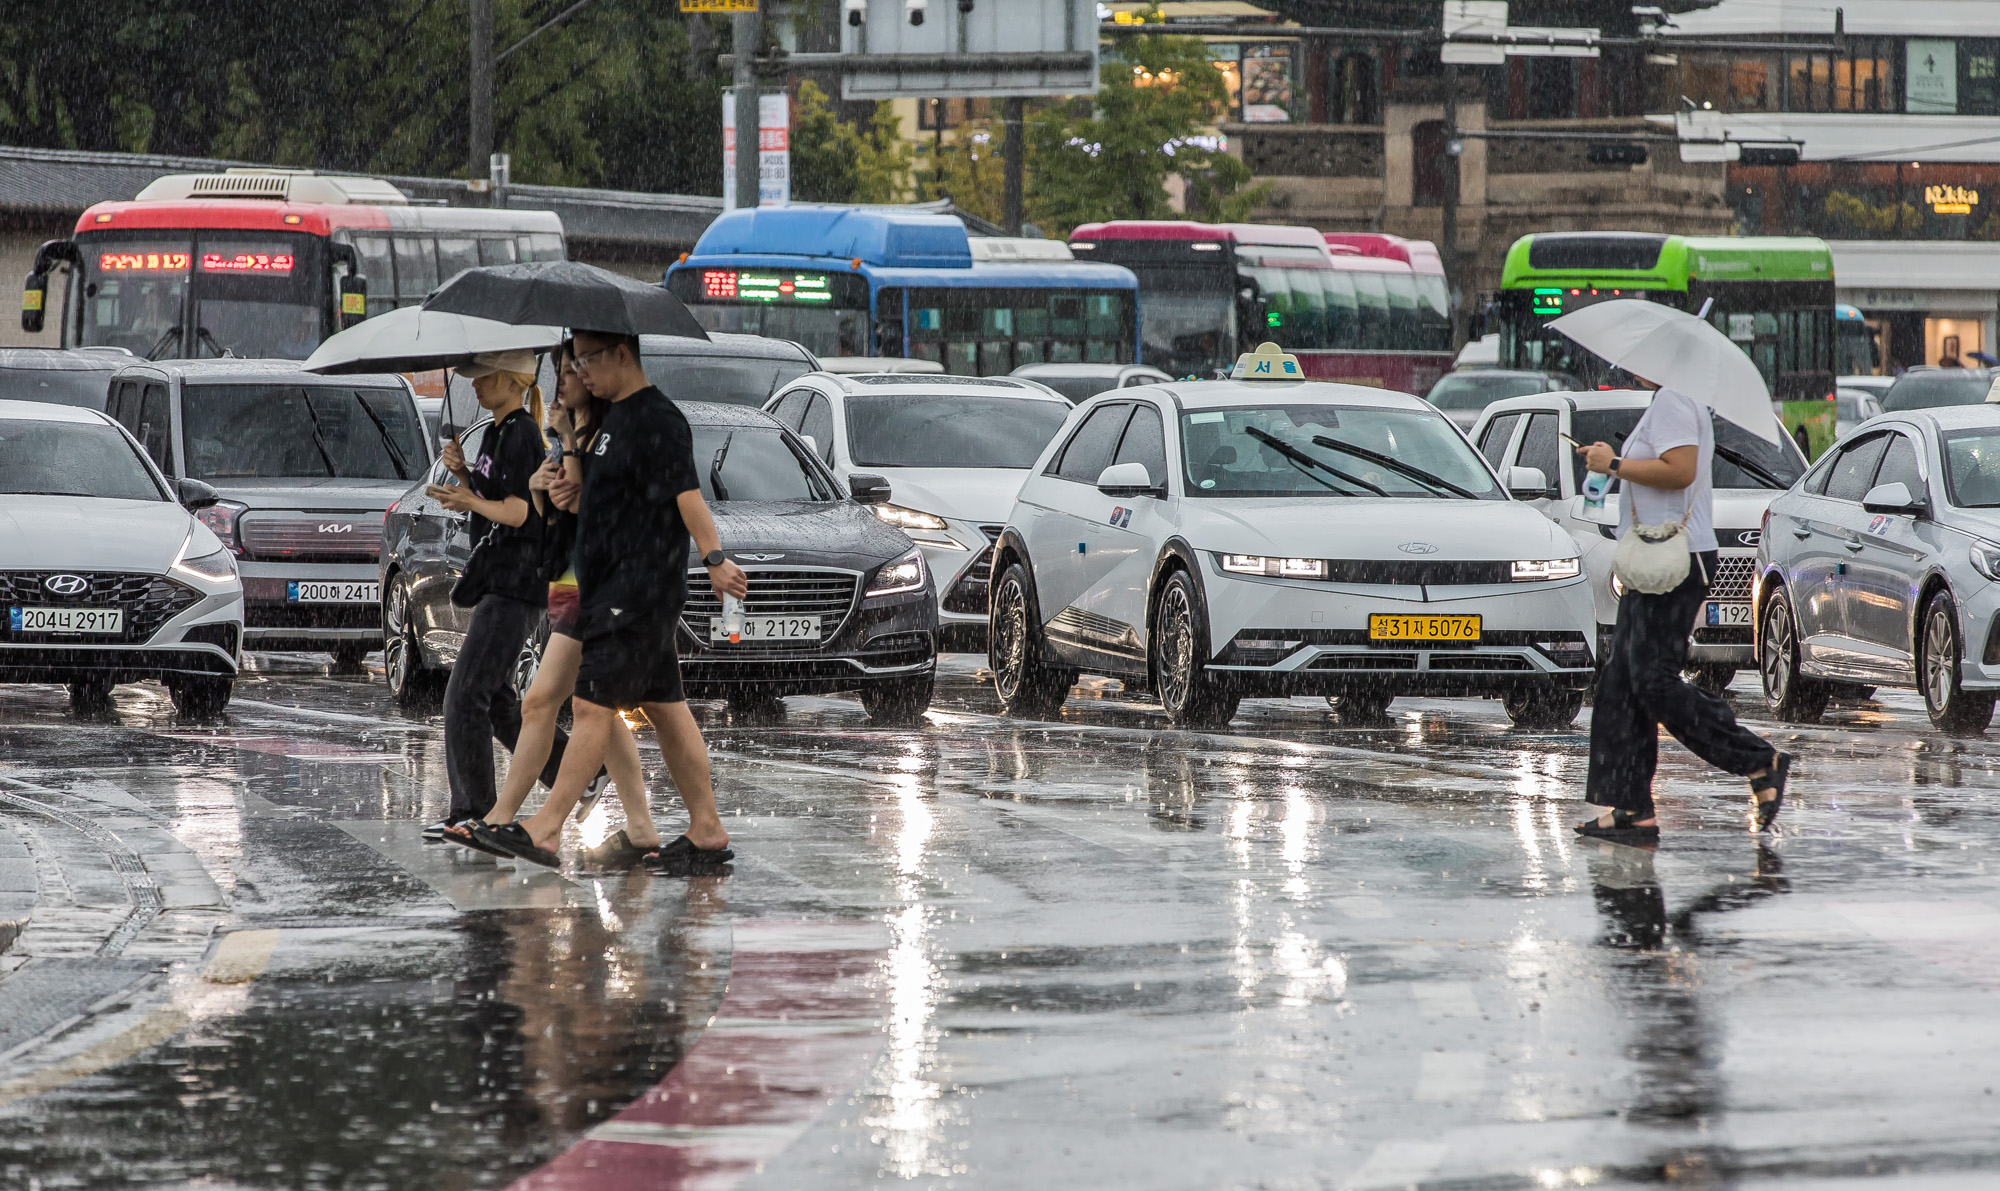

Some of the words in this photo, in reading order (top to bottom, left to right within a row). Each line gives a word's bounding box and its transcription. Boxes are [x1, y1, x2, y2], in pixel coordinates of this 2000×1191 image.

[1254, 360, 1297, 374] 서울
[318, 523, 352, 533] KIA
[300, 584, 341, 600] 200하
[344, 584, 380, 600] 2411
[24, 610, 71, 629] 204너
[75, 611, 119, 630] 2917
[1721, 606, 1754, 623] 192
[765, 619, 811, 637] 2129
[1428, 619, 1474, 637] 5076
